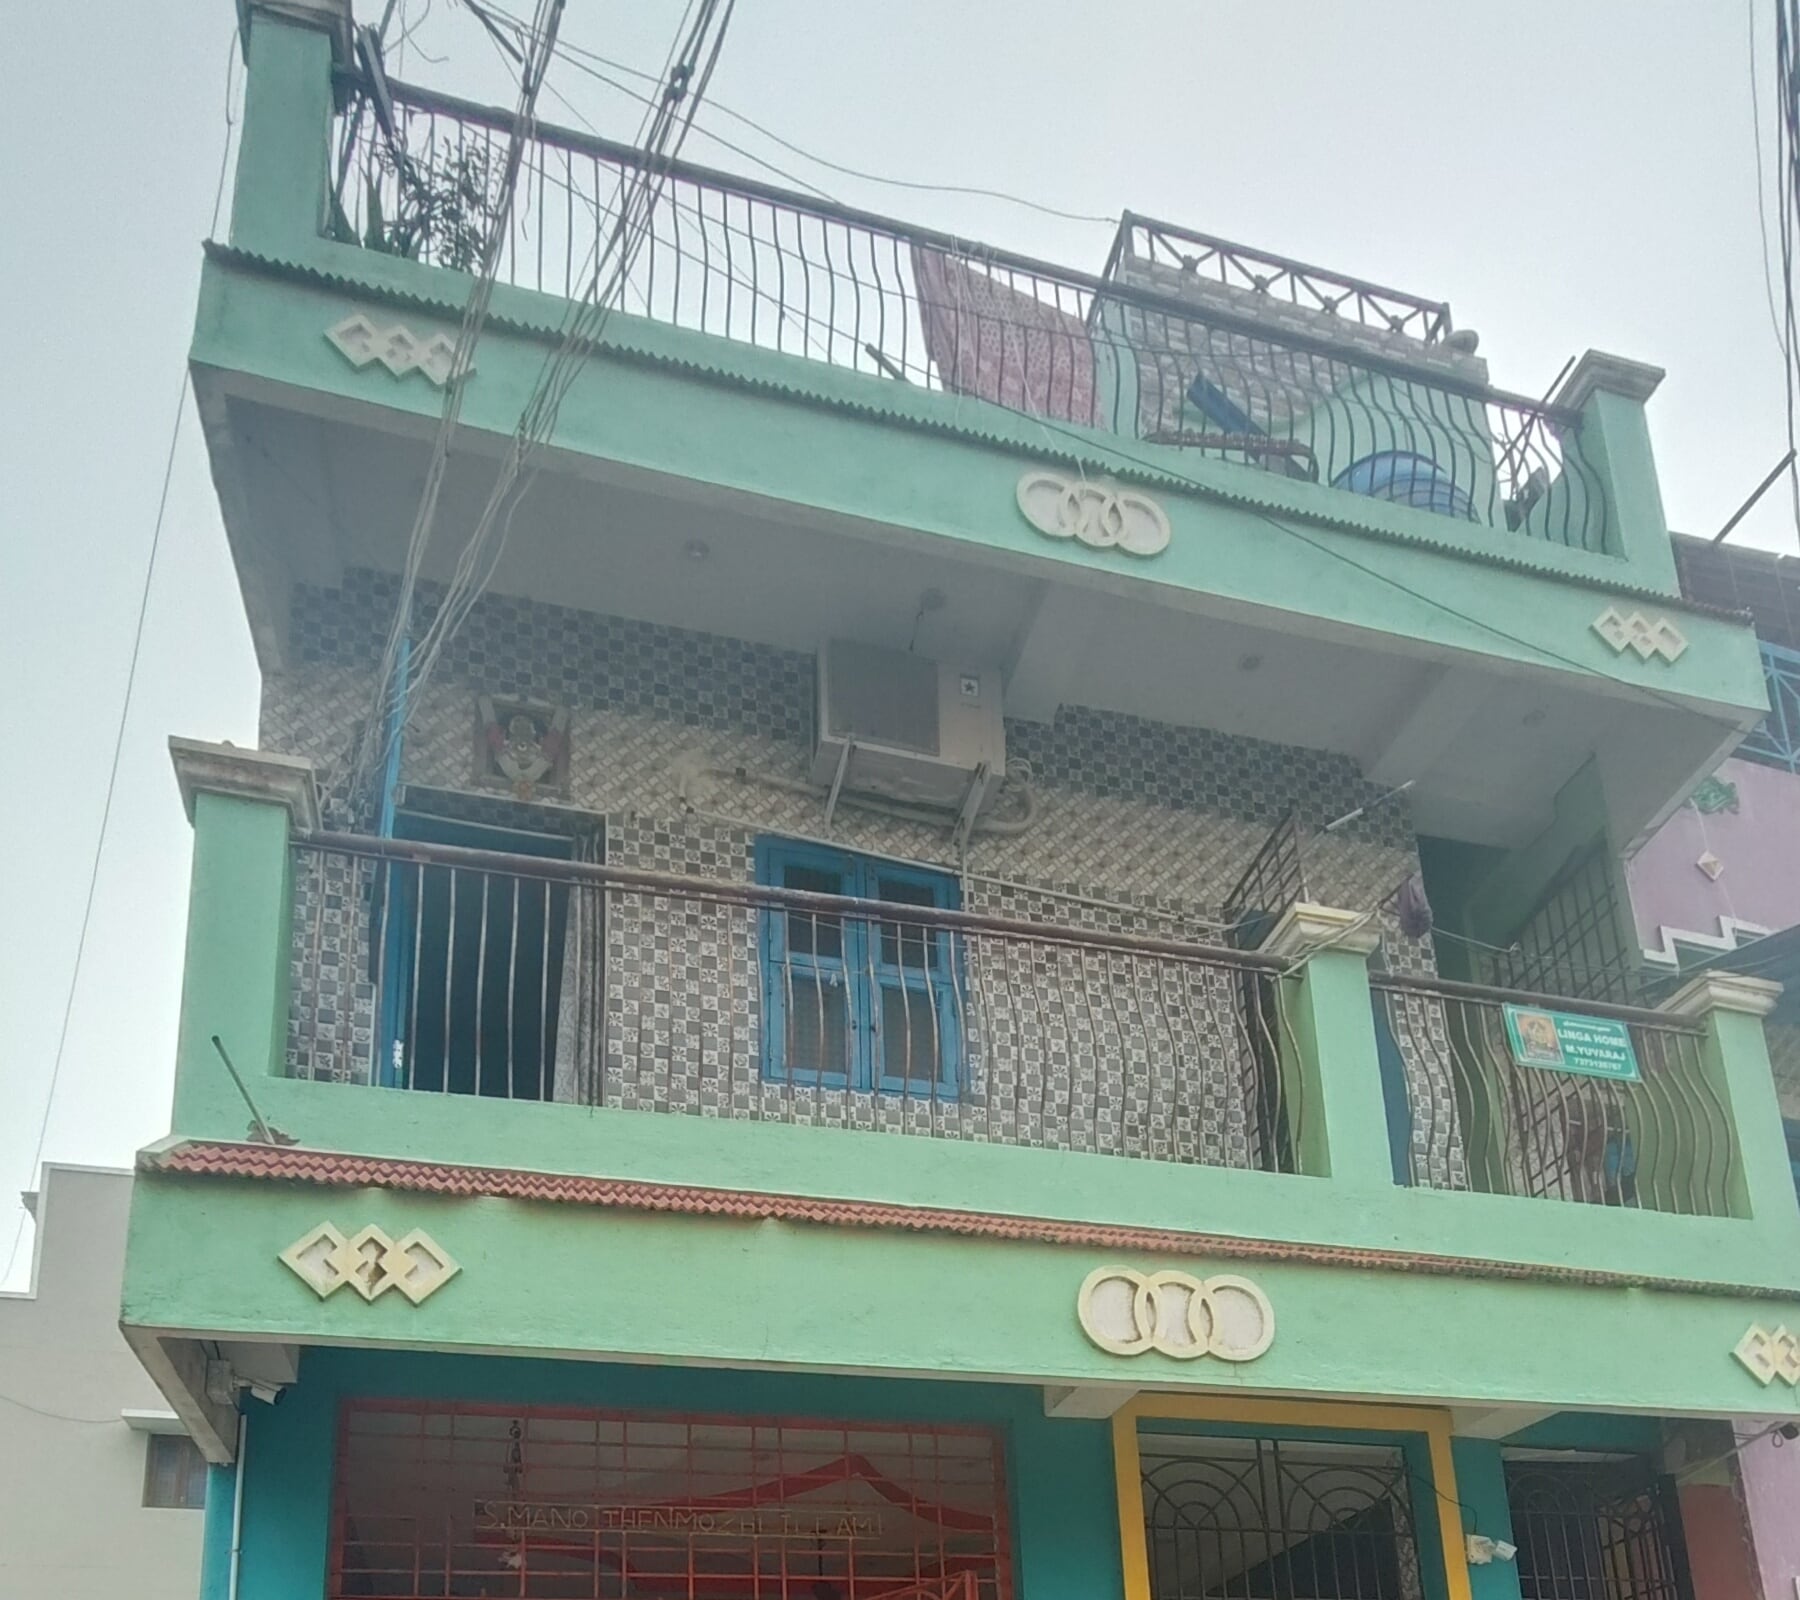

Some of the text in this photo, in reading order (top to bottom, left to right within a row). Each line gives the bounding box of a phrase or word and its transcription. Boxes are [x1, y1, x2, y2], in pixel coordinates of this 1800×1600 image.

[1557, 1028, 1627, 1047] LINGA HOME
[1565, 1044, 1625, 1061] M.YUVARAJ
